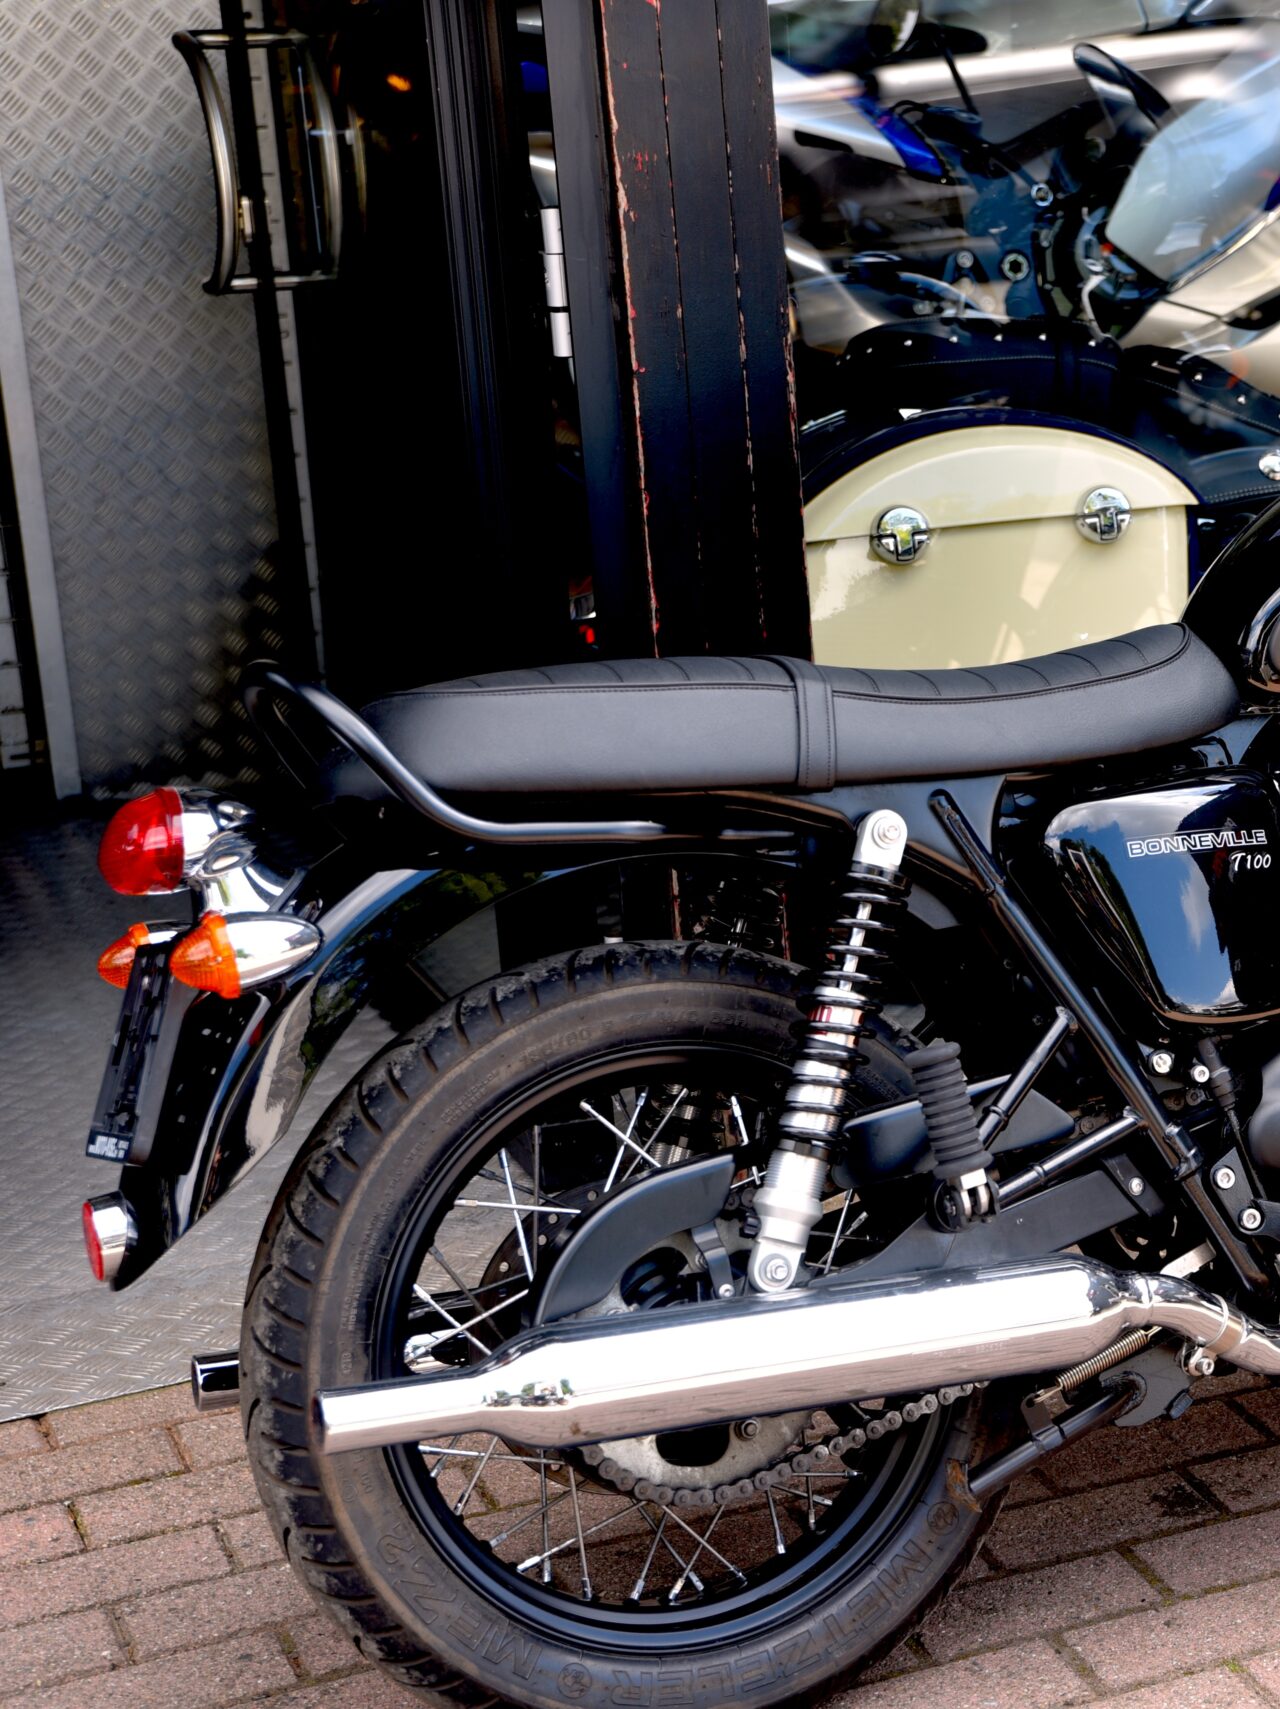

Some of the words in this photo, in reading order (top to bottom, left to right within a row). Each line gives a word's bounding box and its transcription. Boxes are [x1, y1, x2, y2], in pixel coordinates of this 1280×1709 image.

[1126, 829, 1268, 858] BONNEVILLE
[1230, 852, 1271, 872] T100
[611, 1538, 934, 1708] METZELER
